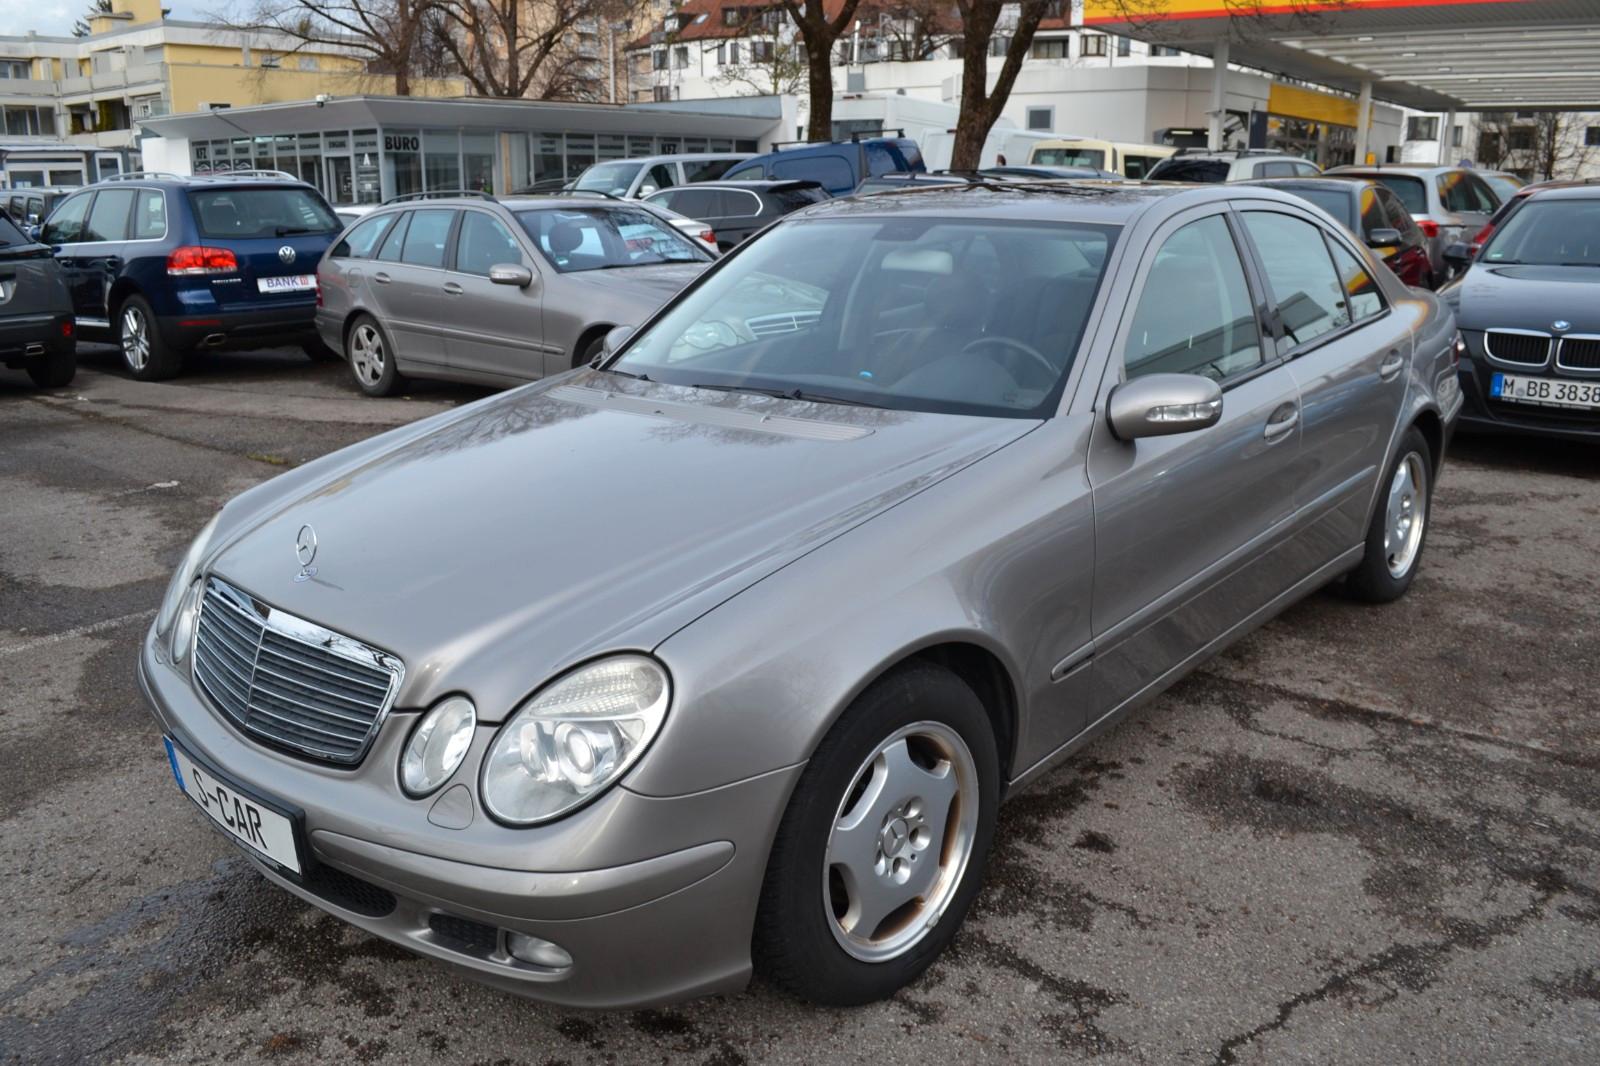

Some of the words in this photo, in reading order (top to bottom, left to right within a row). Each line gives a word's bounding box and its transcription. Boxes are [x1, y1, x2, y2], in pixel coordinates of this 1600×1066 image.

[266, 277, 299, 288] BANK
[1503, 378, 1515, 395] M
[1526, 380, 1550, 398] BB
[1555, 383, 1600, 403] 3838
[192, 768, 268, 849] S-CAR
